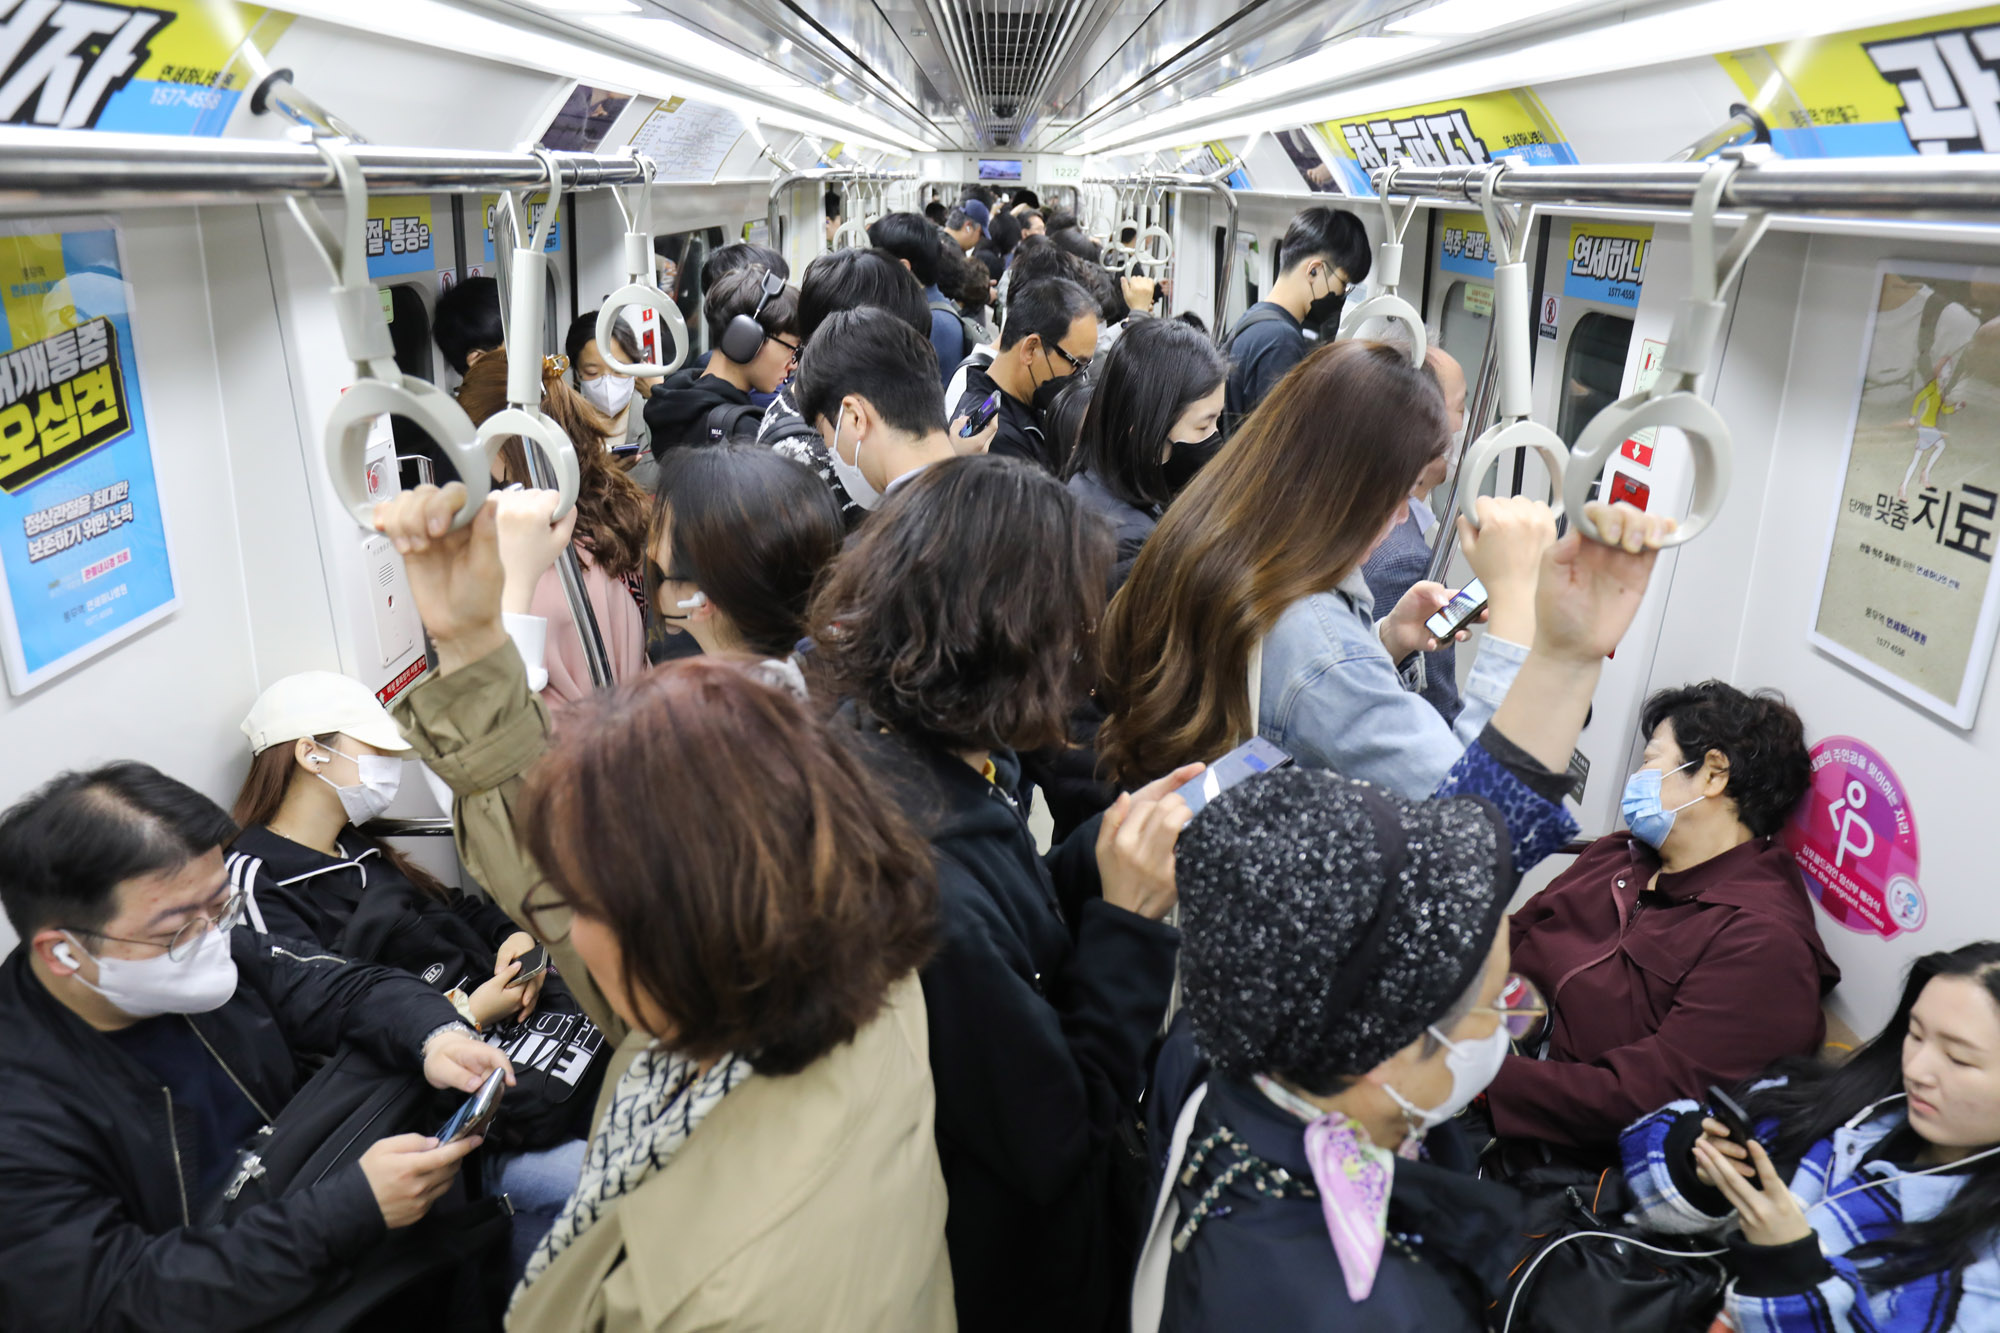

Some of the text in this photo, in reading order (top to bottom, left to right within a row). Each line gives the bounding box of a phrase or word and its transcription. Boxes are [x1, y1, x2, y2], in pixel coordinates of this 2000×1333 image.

[1055, 167, 1080, 177] 1222
[82, 511, 110, 541] 위한
[109, 501, 134, 530] 노력
[1875, 492, 1910, 531] 맞춤
[1912, 482, 1999, 564] 치료
[1894, 808, 1910, 834] 자리
[1808, 862, 1818, 874] for
[1818, 870, 1829, 884] the
[1829, 881, 1859, 909] pregnant
[1859, 904, 1885, 929] woman
